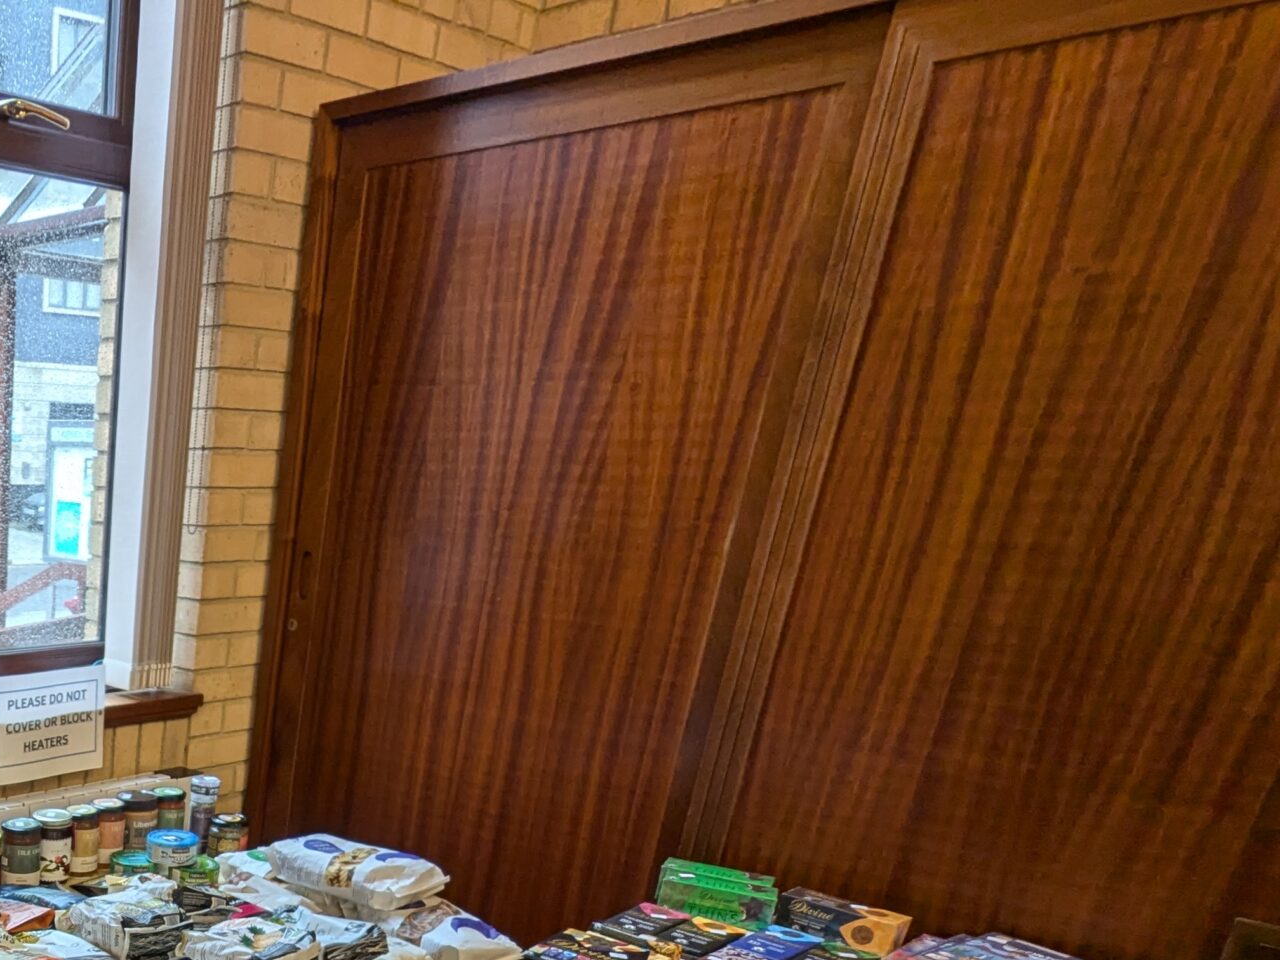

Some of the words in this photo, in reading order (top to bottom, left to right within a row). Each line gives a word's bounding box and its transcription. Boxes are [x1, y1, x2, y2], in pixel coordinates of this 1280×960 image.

[7, 695, 46, 711] PLEASE
[49, 693, 64, 705] DO
[66, 689, 88, 702] NOT
[6, 719, 42, 735] COVER
[43, 716, 58, 729] OR
[60, 711, 93, 725] BLOCK
[23, 734, 69, 753] HEATERS
[790, 900, 836, 922] Divine
